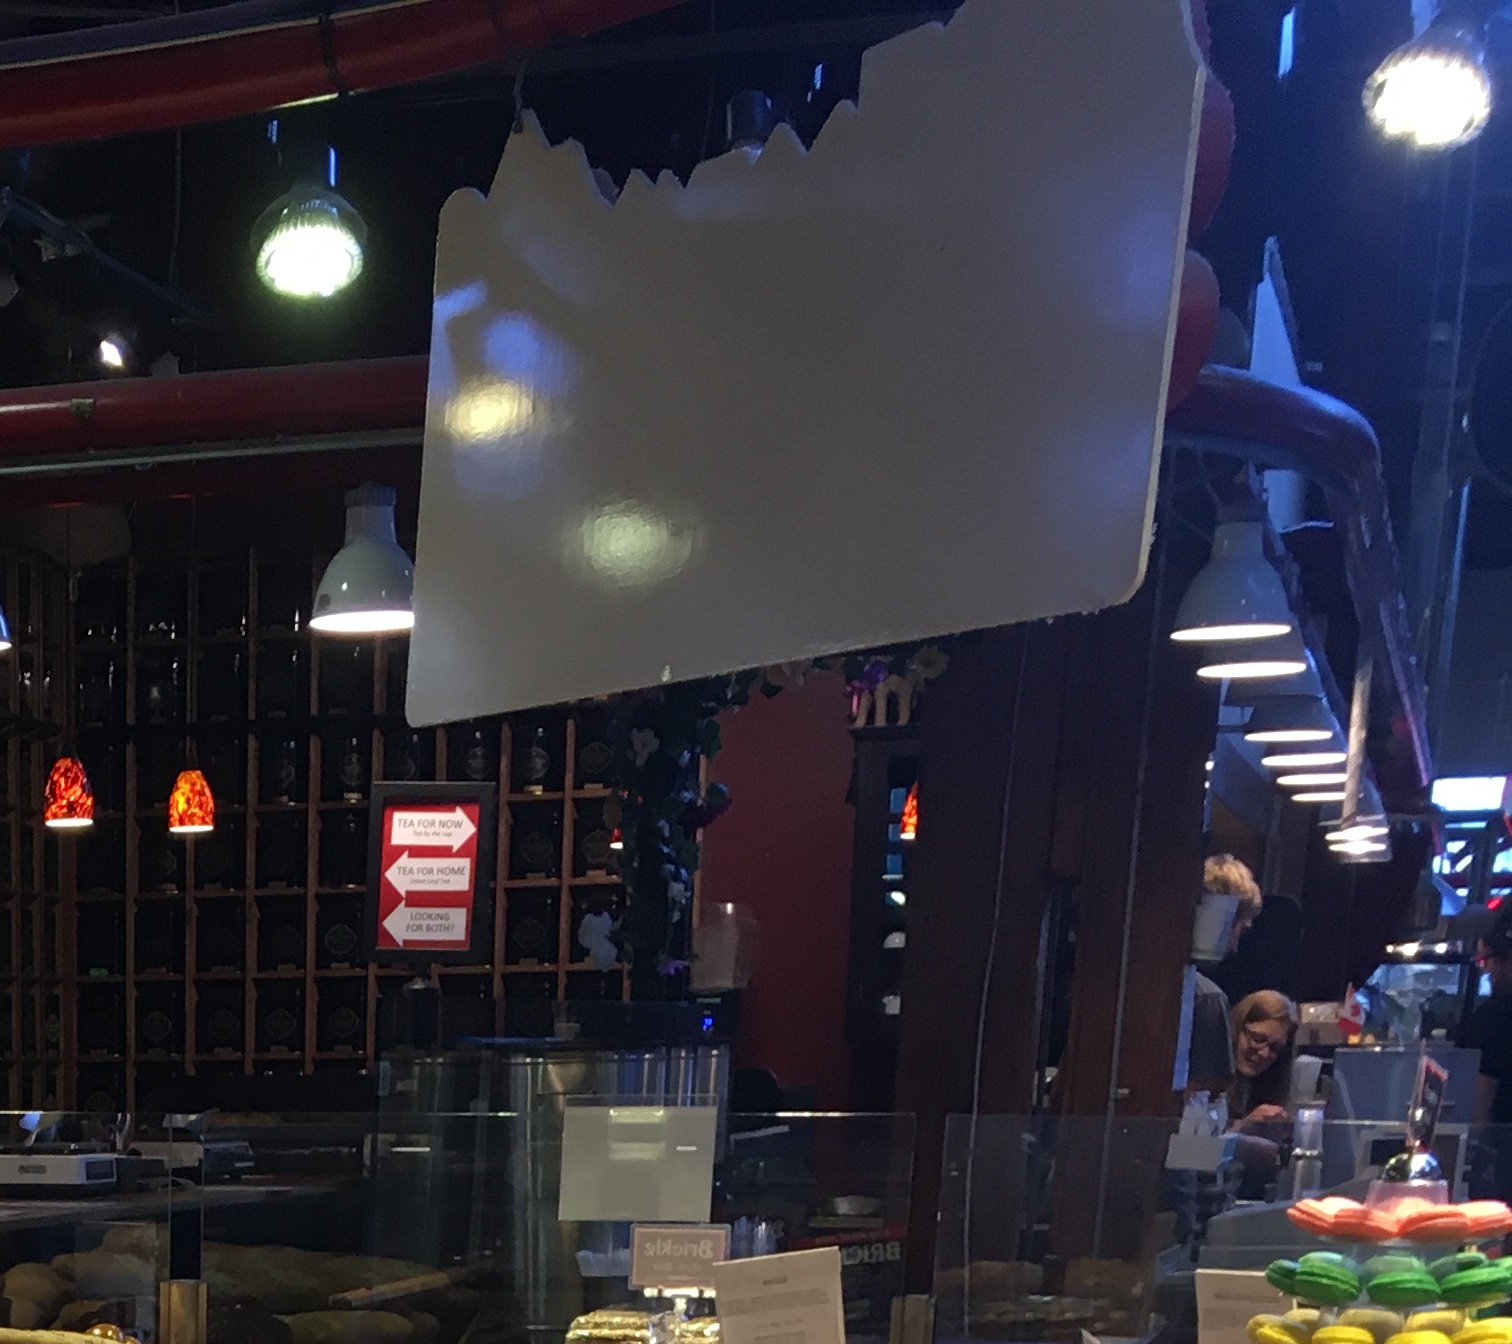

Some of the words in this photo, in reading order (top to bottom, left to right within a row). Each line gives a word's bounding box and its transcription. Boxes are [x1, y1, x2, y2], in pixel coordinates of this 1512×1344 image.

[397, 818, 415, 828] TEA
[417, 819, 436, 828] FOR
[438, 819, 464, 829] NOW
[397, 866, 415, 875] TEA
[416, 866, 435, 875] FOR
[437, 866, 466, 875] HOME
[410, 912, 450, 921] LOOKING
[406, 923, 424, 933] FOR
[425, 923, 455, 933] BOTH?
